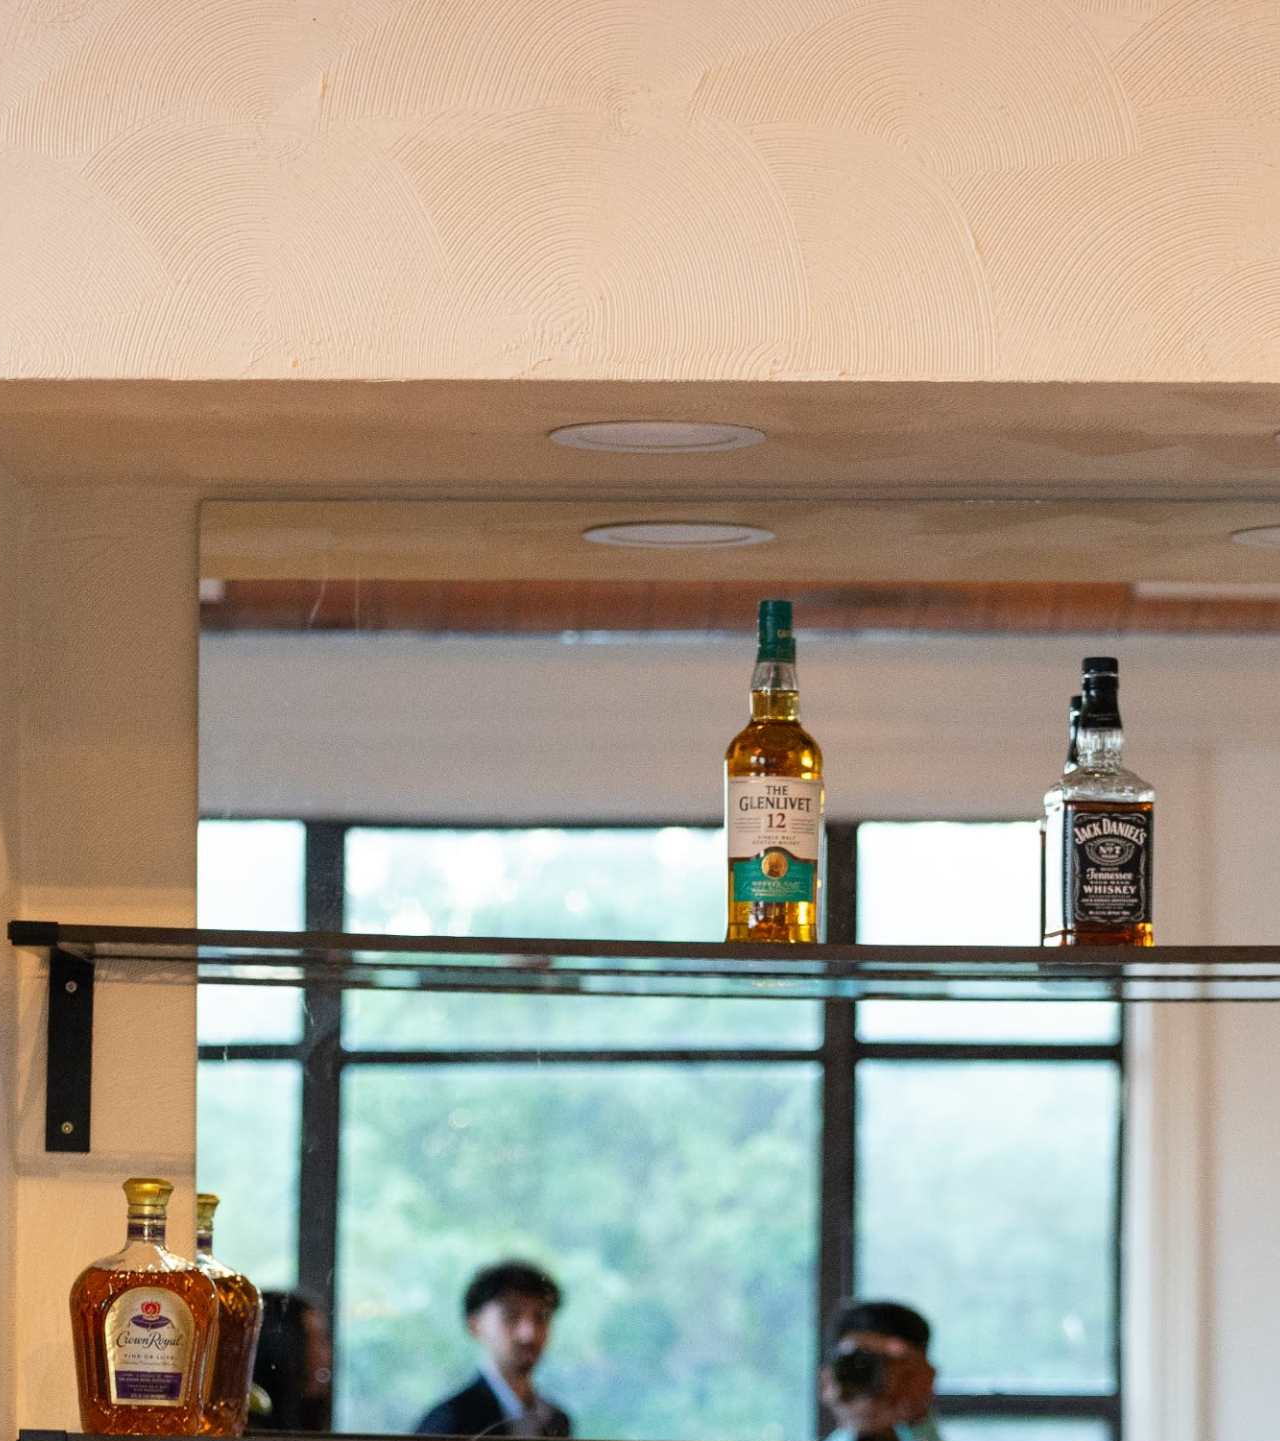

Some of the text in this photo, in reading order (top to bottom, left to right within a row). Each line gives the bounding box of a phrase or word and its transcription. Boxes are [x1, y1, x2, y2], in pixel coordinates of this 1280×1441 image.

[766, 785, 788, 796] THE
[738, 796, 812, 813] GLENLIVET
[767, 812, 786, 828] 12
[1074, 822, 1102, 845] JACK
[1082, 885, 1137, 895] WHISKEY
